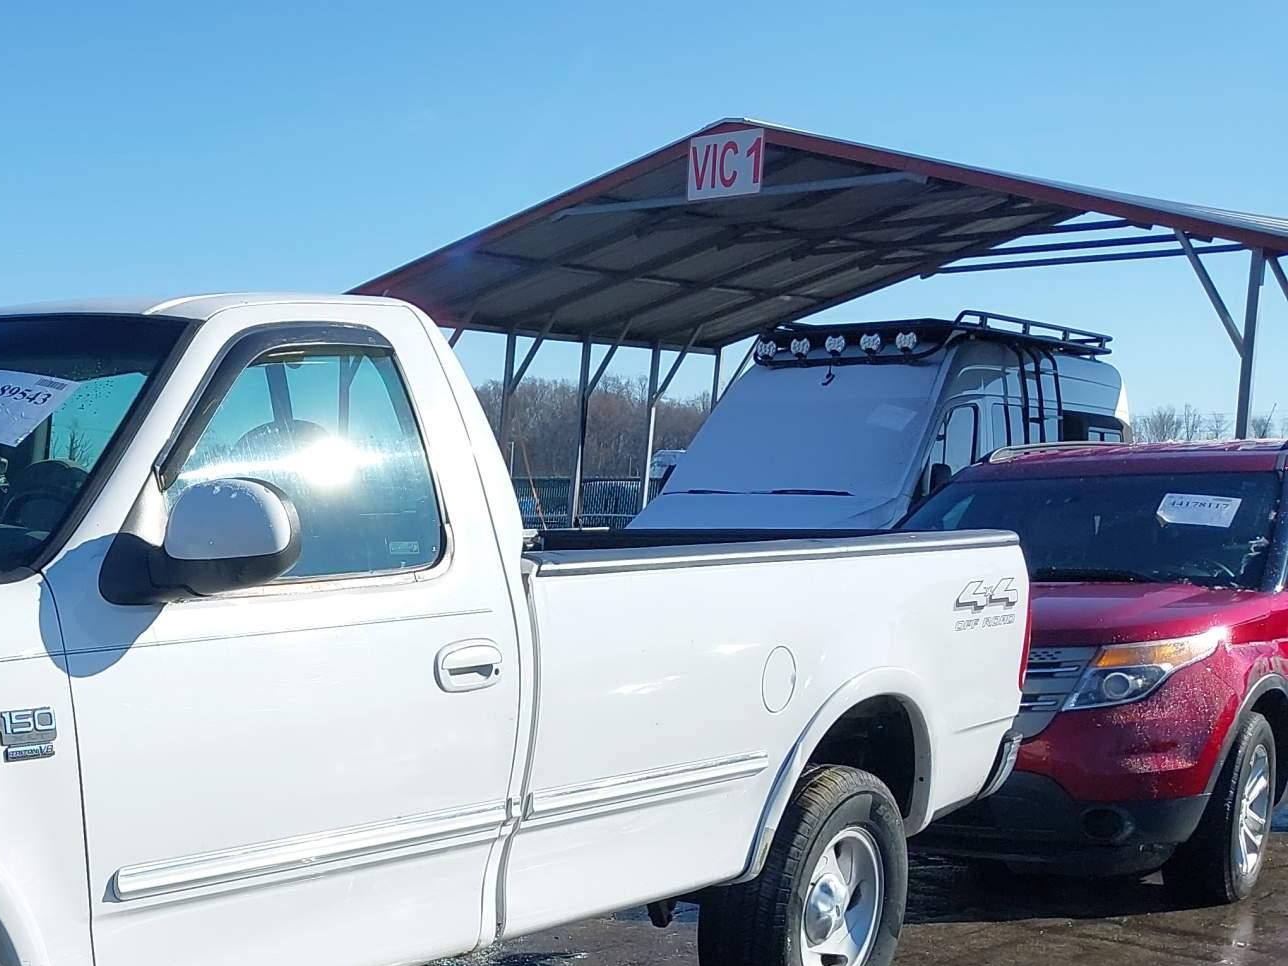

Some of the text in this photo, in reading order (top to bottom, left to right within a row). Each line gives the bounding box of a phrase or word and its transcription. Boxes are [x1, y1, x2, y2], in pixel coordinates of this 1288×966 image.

[691, 137, 762, 190] VIC 1
[954, 613, 1016, 632] OFF ROAD
[39, 744, 54, 754] V8
